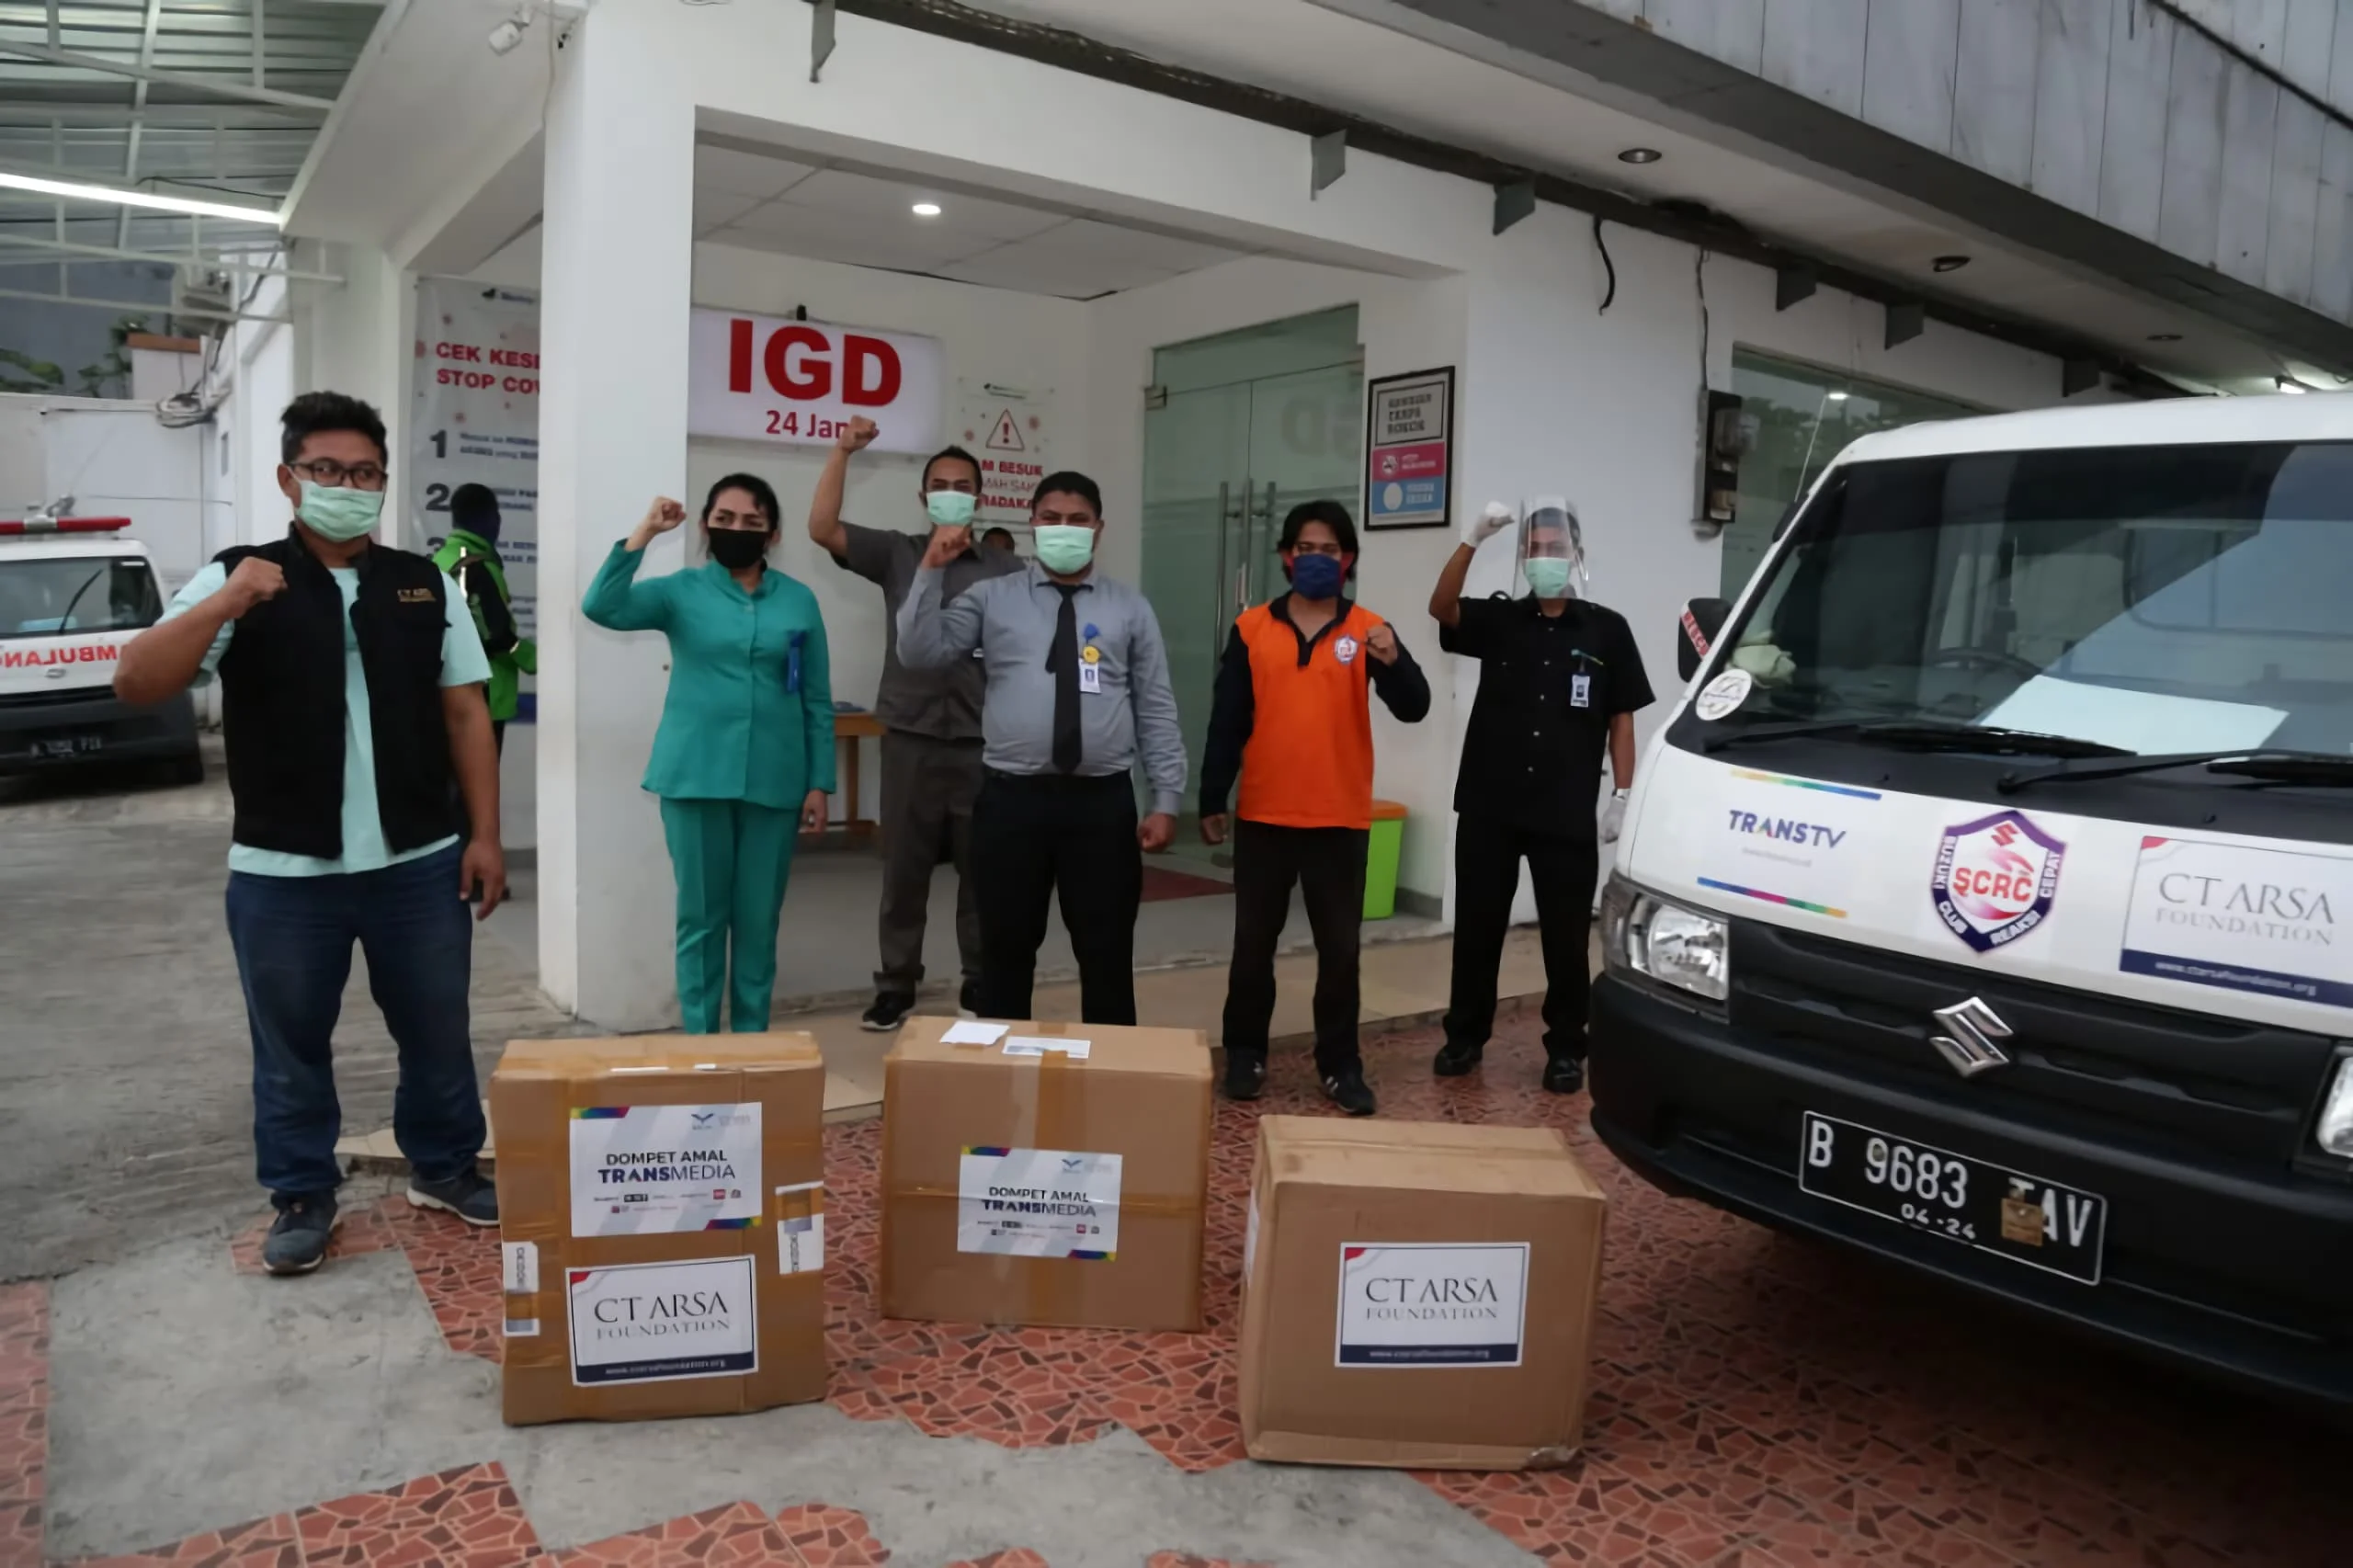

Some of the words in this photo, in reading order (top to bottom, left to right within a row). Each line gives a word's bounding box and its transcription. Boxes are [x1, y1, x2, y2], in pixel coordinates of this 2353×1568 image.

[436, 342, 481, 363] CEK
[729, 318, 902, 407] IGD
[437, 368, 495, 390] STOP
[502, 376, 540, 395] CO
[766, 410, 799, 436] 24
[429, 429, 447, 459] 1
[999, 461, 1042, 475] BESUK
[426, 483, 451, 512] 2
[1952, 867, 2033, 903] SCRC
[2039, 851, 2062, 898] CEPAT
[2159, 873, 2222, 906] CT
[2225, 882, 2335, 924] ARSA
[1938, 900, 1969, 935] CLUB
[2156, 908, 2332, 947] FOUNDATION
[606, 1151, 676, 1166] DOMPET
[680, 1150, 728, 1163] AMAL
[1808, 1119, 1834, 1168] B
[1864, 1137, 1968, 1209] 9683
[597, 1165, 736, 1184] TRANSMEDIA
[982, 1198, 1097, 1218] TRANSMEDIA
[988, 1186, 1047, 1200] DOMPET
[1051, 1189, 1090, 1203] AMAL
[1365, 1278, 1415, 1303] CT
[1419, 1278, 1498, 1303] ARSA
[594, 1297, 642, 1324] CT
[649, 1290, 729, 1319] ARSA
[1366, 1306, 1498, 1321] FOUNDATION
[597, 1319, 731, 1341] FOUNDATION
